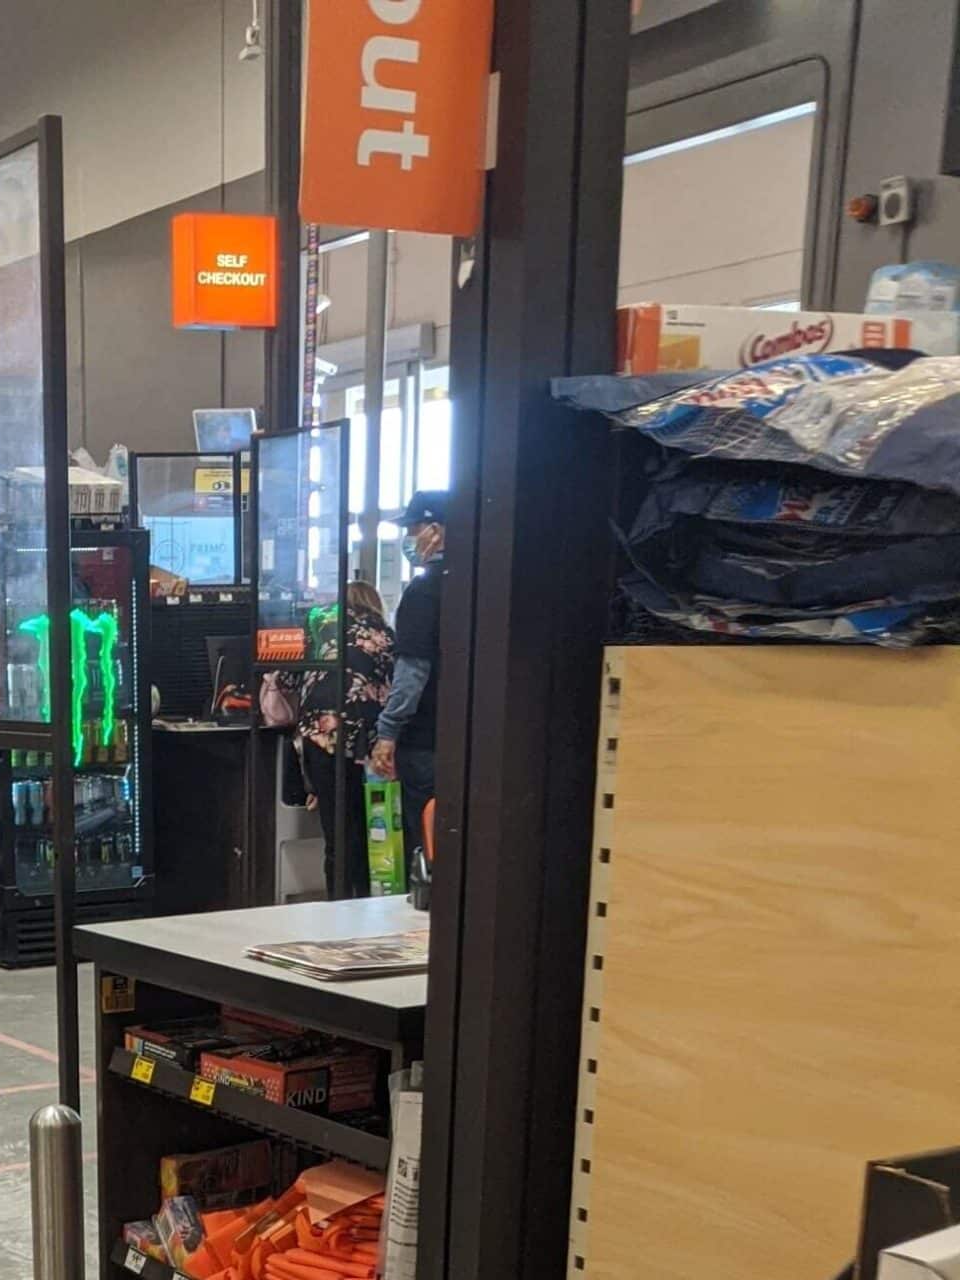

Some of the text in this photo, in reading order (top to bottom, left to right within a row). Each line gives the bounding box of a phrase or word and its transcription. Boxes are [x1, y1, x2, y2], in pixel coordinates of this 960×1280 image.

[217, 254, 248, 268] SELF
[198, 271, 267, 287] CHECKOUT
[751, 318, 831, 364] Combos
[287, 1087, 326, 1107] KIND
